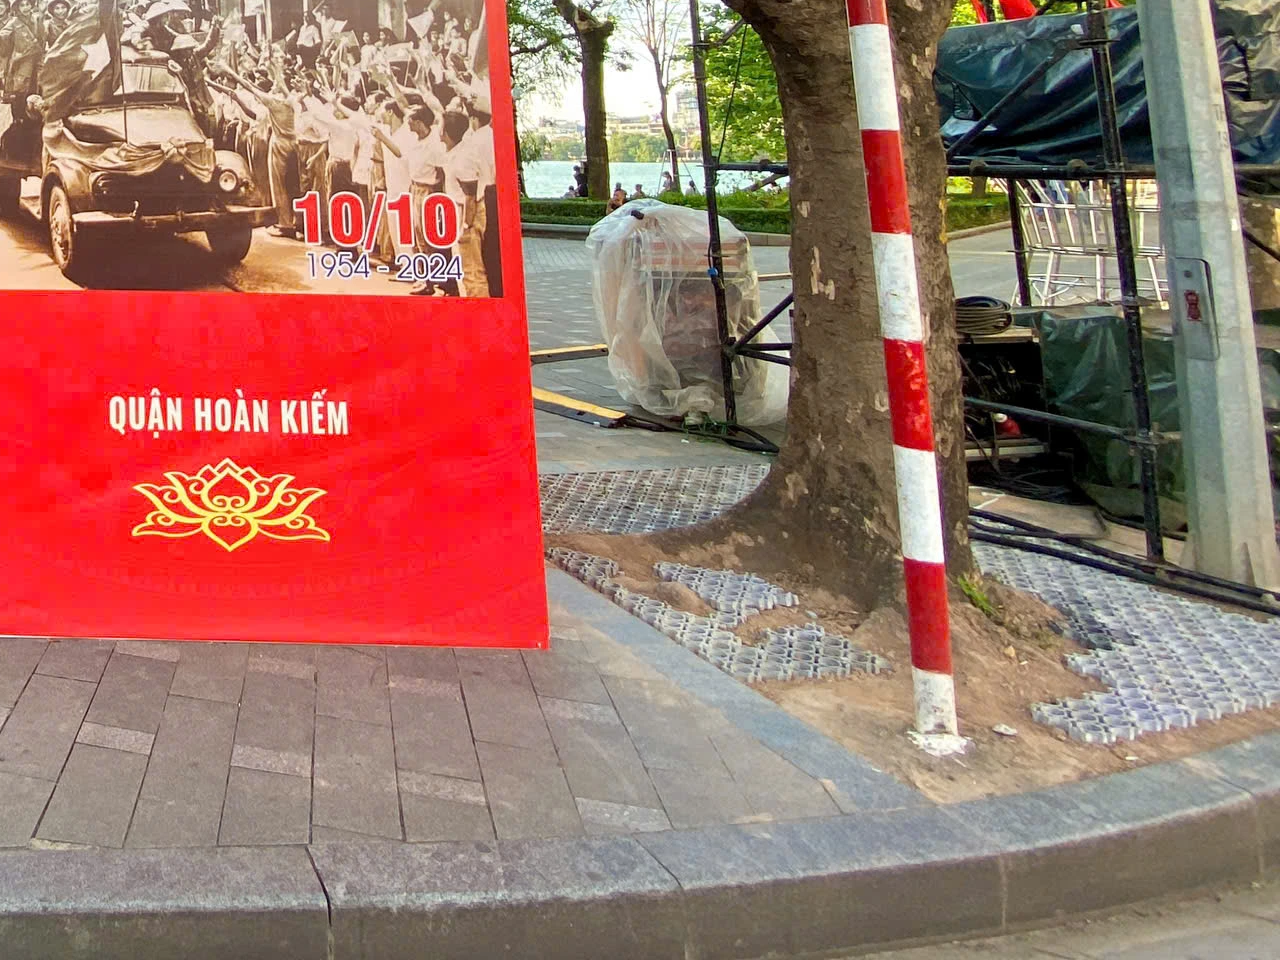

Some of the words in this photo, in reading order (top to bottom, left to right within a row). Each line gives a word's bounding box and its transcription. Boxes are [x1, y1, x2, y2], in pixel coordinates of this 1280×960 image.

[293, 191, 460, 251] 10/10
[306, 253, 370, 279] 1954
[394, 254, 463, 282] 2024
[109, 387, 183, 439] QUẬN
[194, 388, 269, 433] HOÀN
[280, 388, 349, 435] KIẾM
